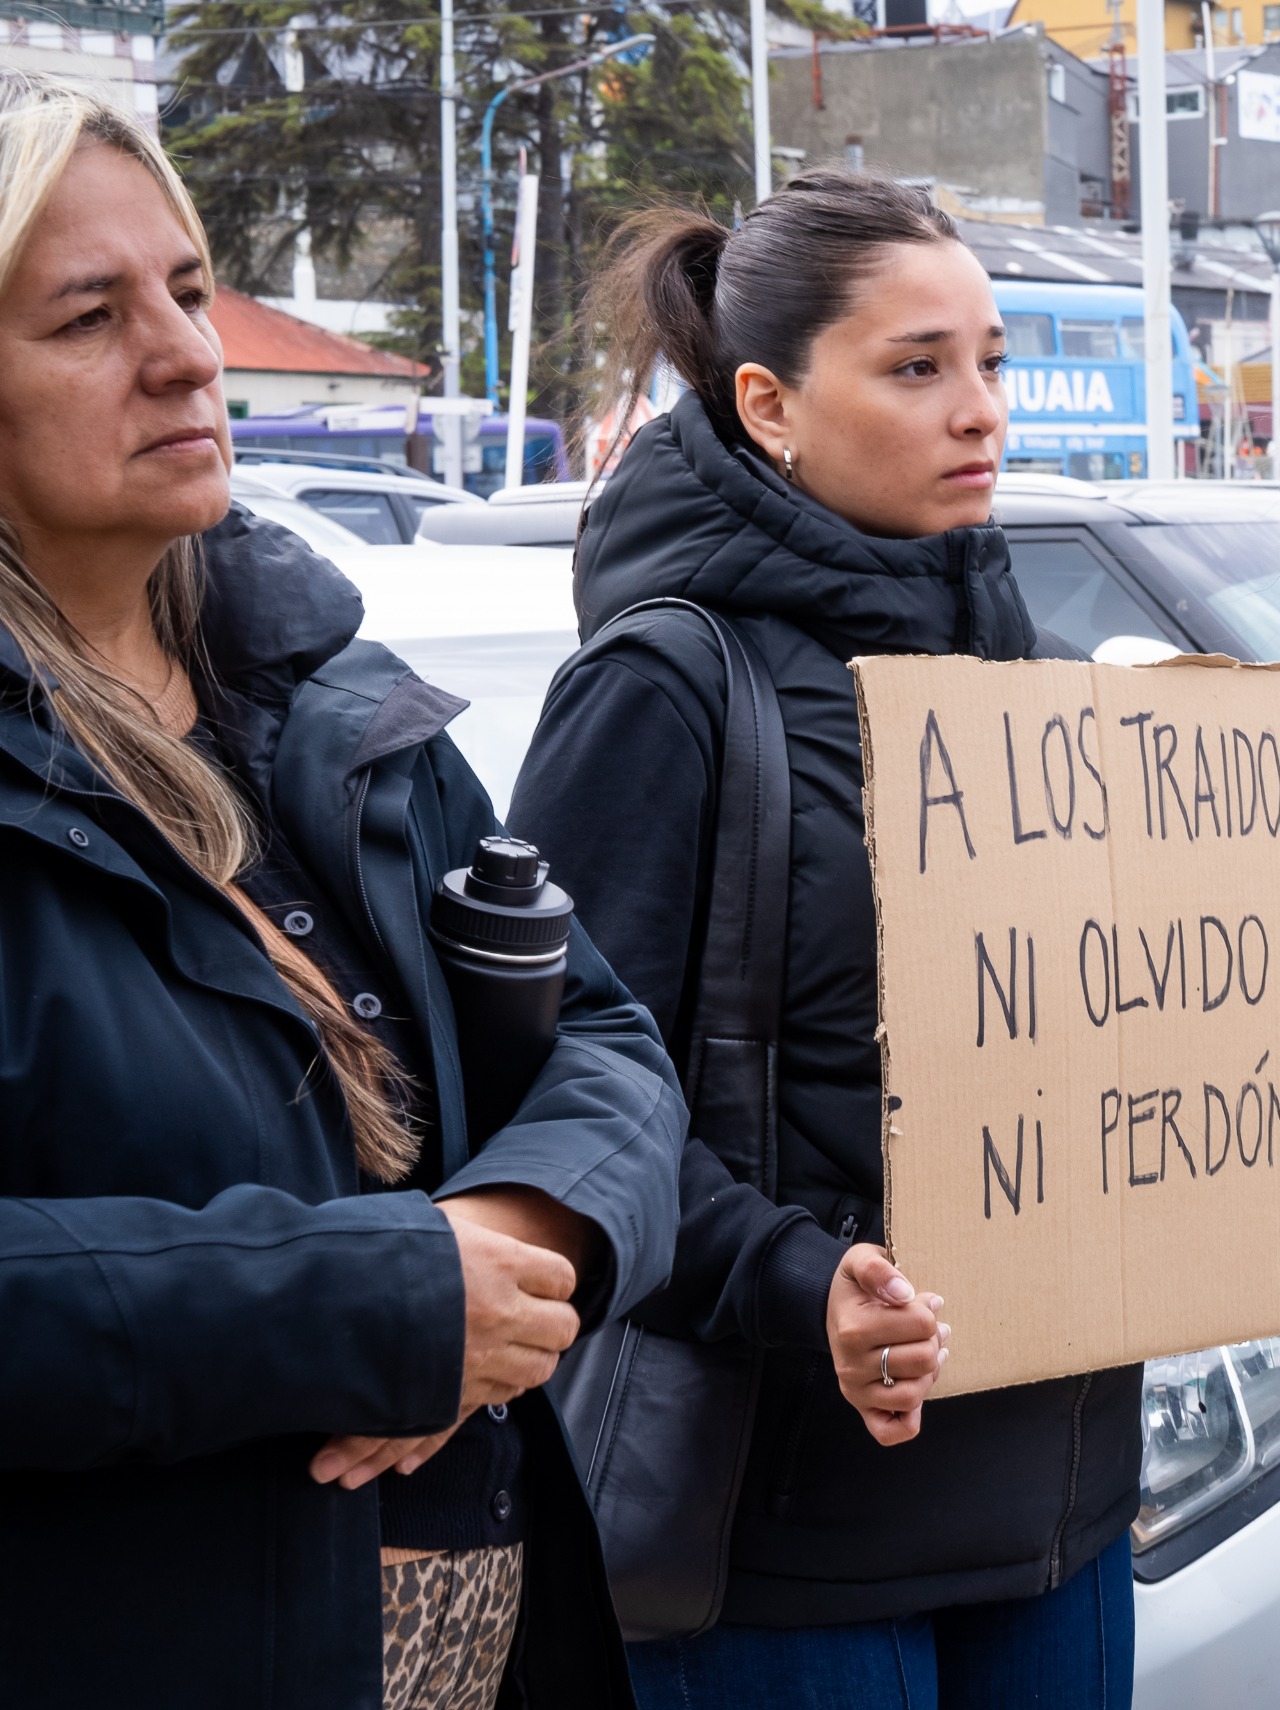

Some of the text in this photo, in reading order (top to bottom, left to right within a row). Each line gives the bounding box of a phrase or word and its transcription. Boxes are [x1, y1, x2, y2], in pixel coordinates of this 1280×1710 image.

[919, 709, 976, 874] A
[1003, 707, 1110, 844] LOS
[975, 927, 1037, 1048] NI
